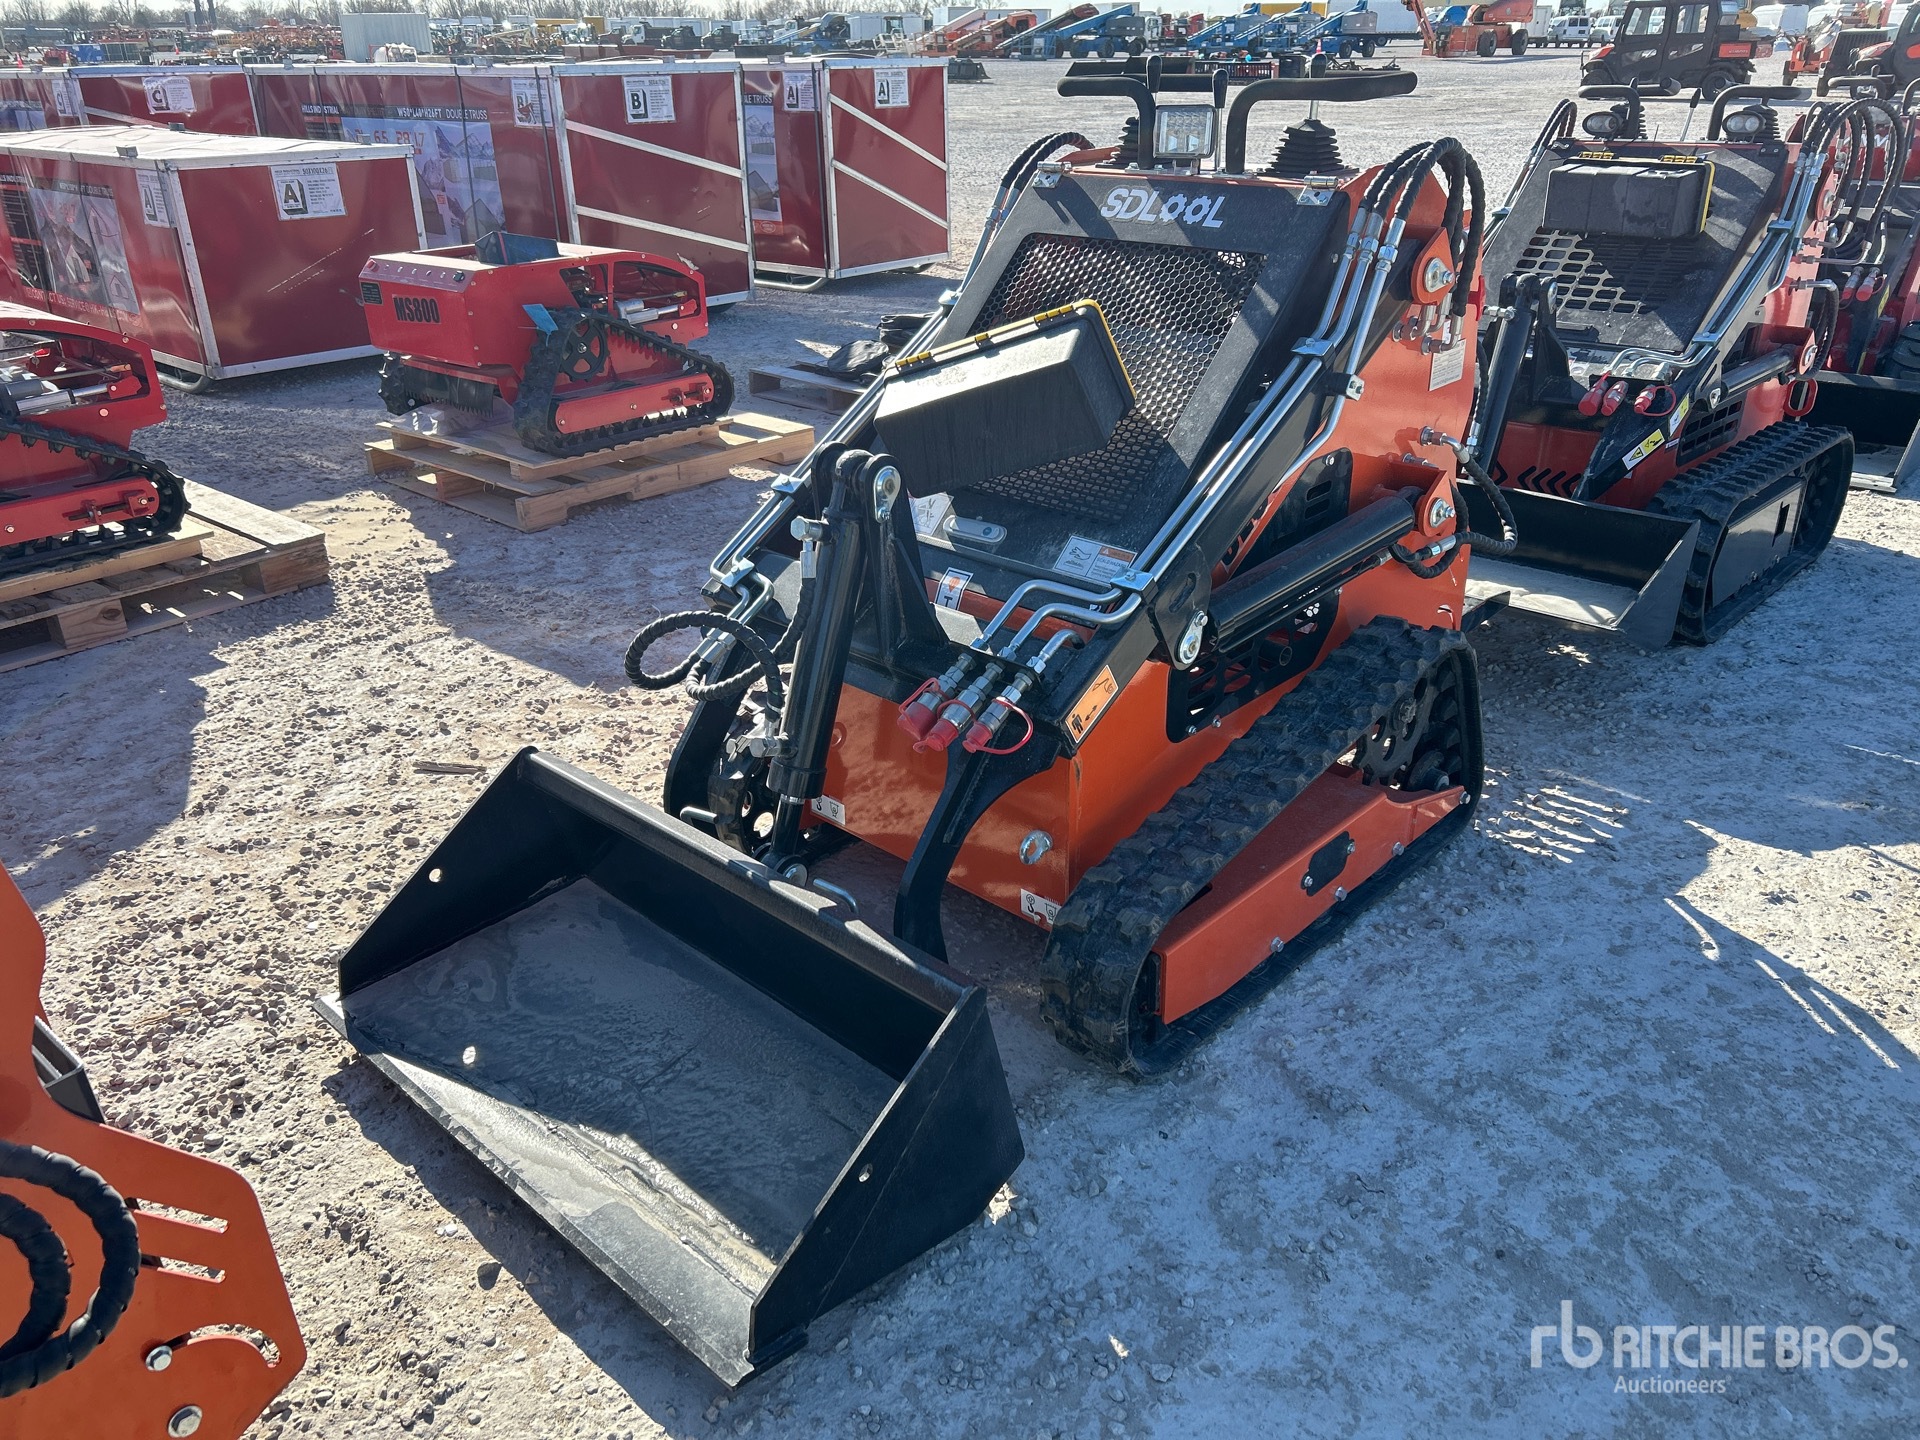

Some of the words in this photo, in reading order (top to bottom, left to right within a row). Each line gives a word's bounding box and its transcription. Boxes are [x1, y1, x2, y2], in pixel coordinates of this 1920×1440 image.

[152, 90, 163, 103] C
[787, 86, 796, 100] A
[878, 82, 887, 97] A
[631, 92, 642, 110] B
[313, 105, 340, 115] INDSTRIAL
[445, 108, 468, 119] DOUBE
[468, 109, 488, 120] TRUSS
[143, 188, 153, 209] A
[283, 184, 300, 204] A
[393, 296, 441, 323] MS800
